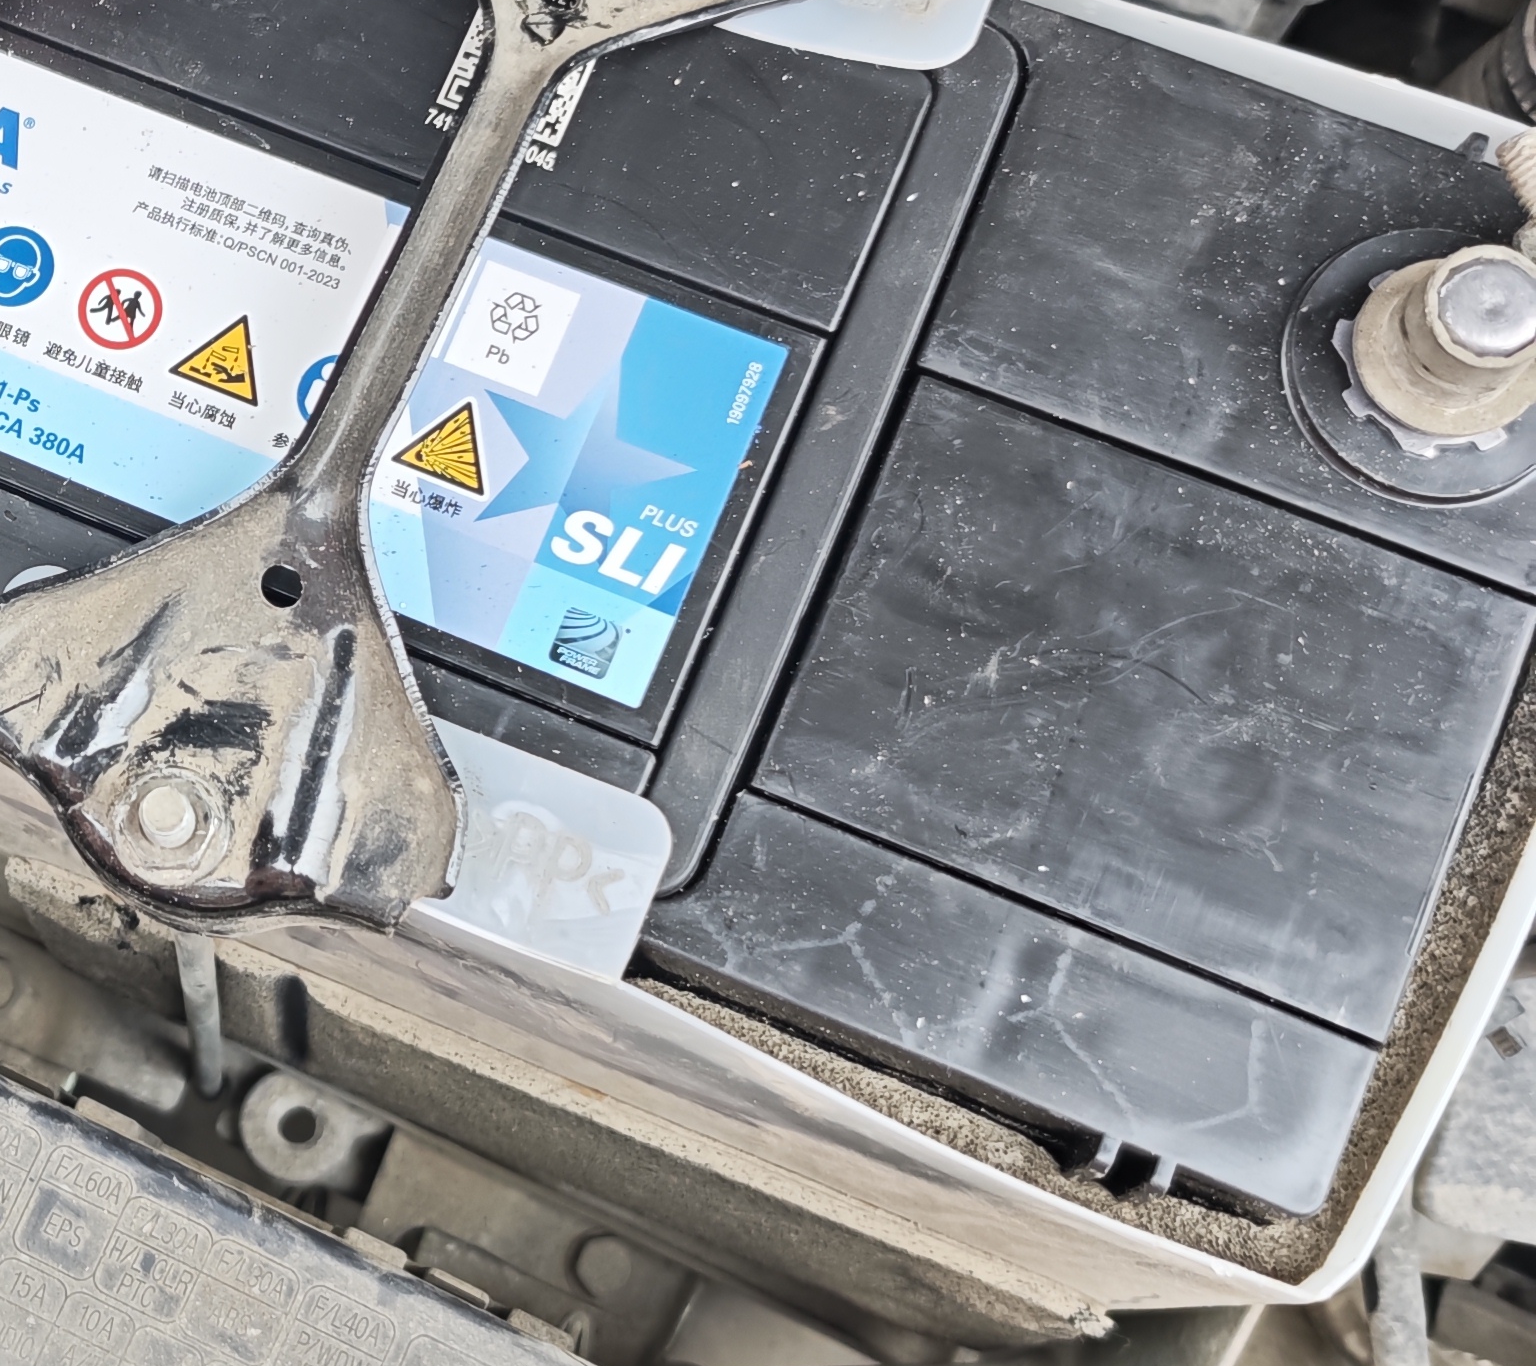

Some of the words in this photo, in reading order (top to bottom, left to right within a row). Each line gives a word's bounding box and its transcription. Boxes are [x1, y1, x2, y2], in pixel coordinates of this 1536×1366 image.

[278, 258, 341, 290] 001-2023
[41, 339, 144, 394] 避免儿童接触
[485, 343, 512, 366] Pb
[166, 389, 238, 431] 当心腐蚀
[725, 359, 764, 427] 19097928
[28, 425, 89, 465] 380A
[390, 477, 464, 520] 当心爆炸
[638, 502, 699, 541] PLUS
[545, 500, 688, 600] SLI
[556, 645, 598, 667] POWER
[558, 653, 601, 676] FRAME
[52, 1153, 127, 1206] F/L60A
[42, 1212, 87, 1249] EPS
[128, 1204, 203, 1257] F/L30A
[107, 1235, 151, 1273] H/L
[147, 1255, 196, 1295] CLR
[214, 1248, 289, 1301] F/L30A
[6, 1270, 52, 1307] 15A
[114, 1272, 158, 1309] PTC
[73, 1303, 119, 1341] 10A
[308, 1295, 386, 1349] F/L40A
